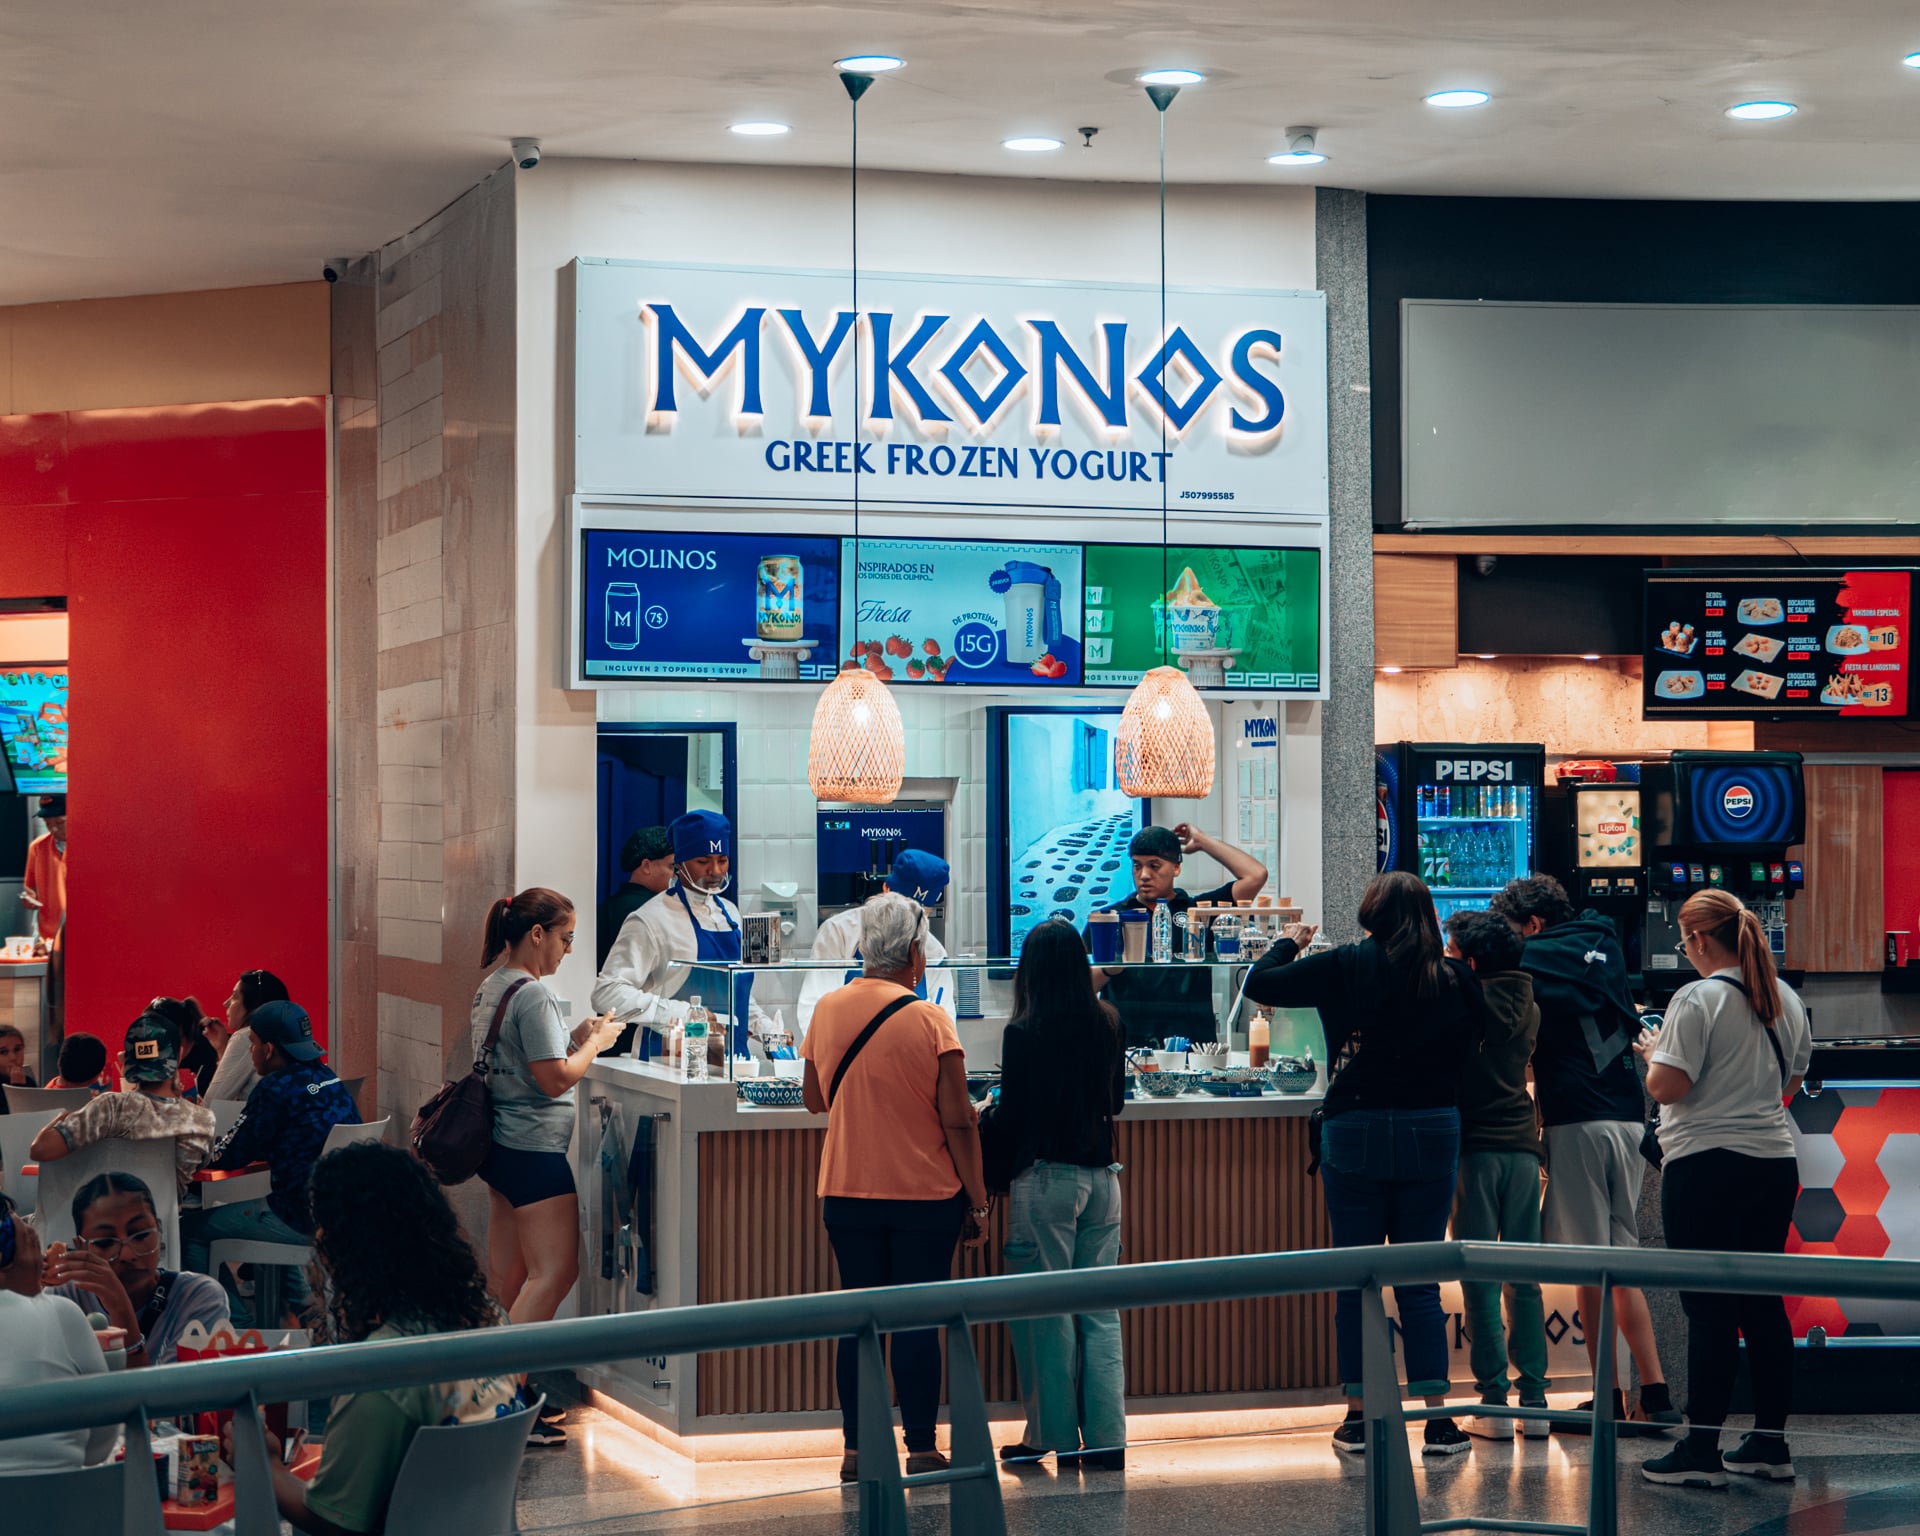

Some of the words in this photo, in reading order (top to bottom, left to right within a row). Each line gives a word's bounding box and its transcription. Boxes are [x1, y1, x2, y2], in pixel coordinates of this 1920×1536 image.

[645, 303, 1285, 433] MYKONOS
[765, 440, 876, 474] GREEK
[887, 443, 1018, 478] FROZEN
[1028, 447, 1173, 483] YOGURT
[1179, 490, 1235, 500] J507995585
[606, 547, 717, 570] MOLINOS
[857, 561, 917, 573] NSPIRADOS
[920, 563, 934, 574] EN
[649, 612, 663, 624] 7$
[856, 600, 912, 623] Fresa
[614, 610, 632, 627] M
[952, 615, 964, 626] DE
[963, 612, 998, 627] PROTEÍNA
[1025, 607, 1034, 648] MYKONOS
[959, 634, 992, 653] 15G
[1881, 632, 1895, 645] 10
[661, 666, 709, 674] TOPPINGS
[718, 667, 748, 675] SYRUP
[1874, 688, 1888, 701] 13
[1435, 759, 1513, 781] PEPSI
[1725, 797, 1751, 806] PEPSI
[861, 827, 902, 838] MYKONOS
[1599, 823, 1625, 834] Lipton
[709, 839, 722, 853] M
[137, 1045, 155, 1056] CAT
